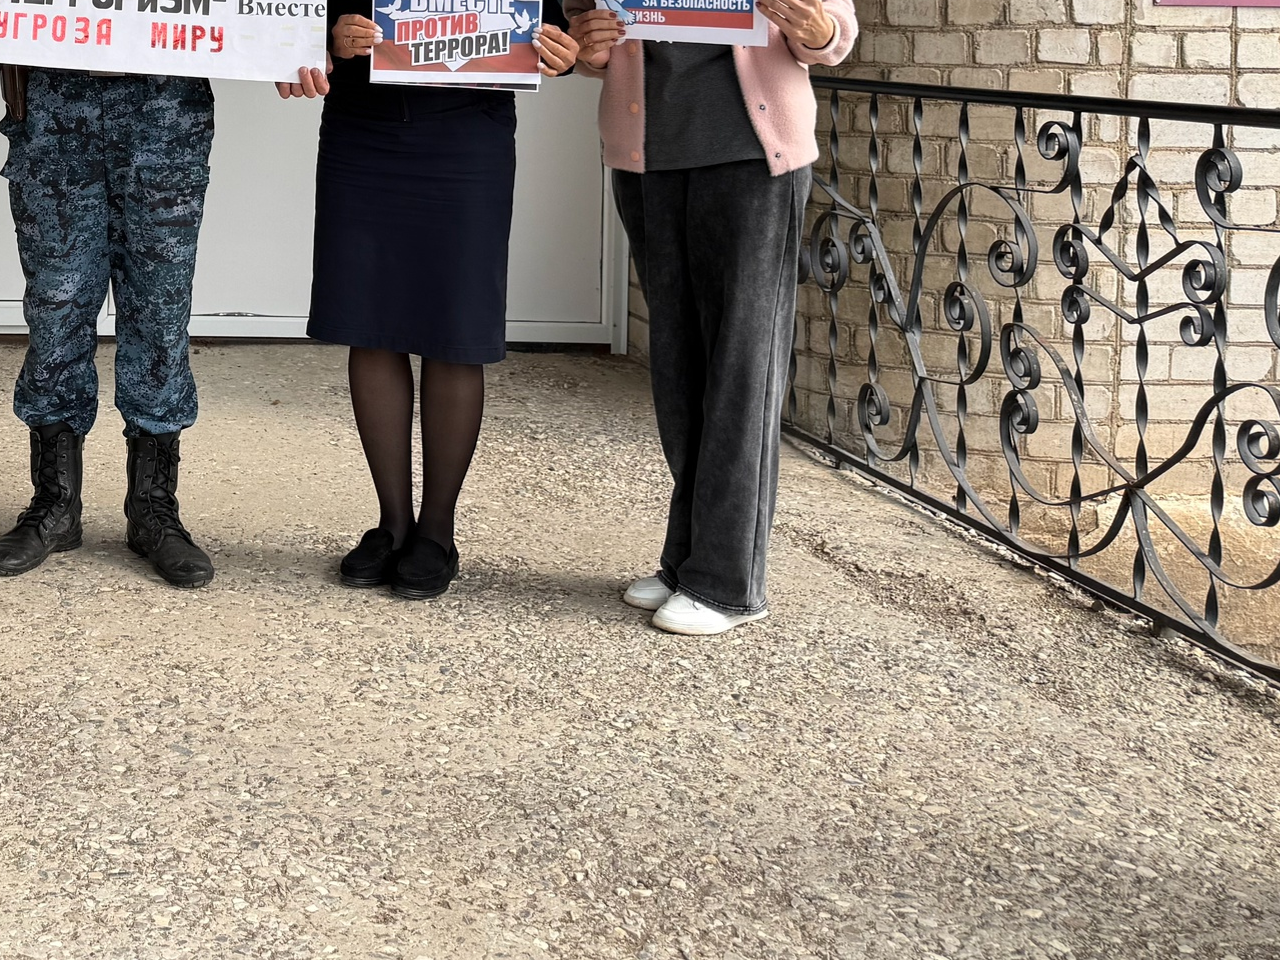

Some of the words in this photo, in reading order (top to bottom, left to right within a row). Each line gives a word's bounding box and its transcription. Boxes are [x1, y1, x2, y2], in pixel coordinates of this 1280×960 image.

[397, 12, 480, 43] ПРОТИВ
[631, 10, 665, 23] ИЗНЬ
[151, 22, 225, 53] МИРУ
[411, 31, 508, 63] ТЕРРОРА!
